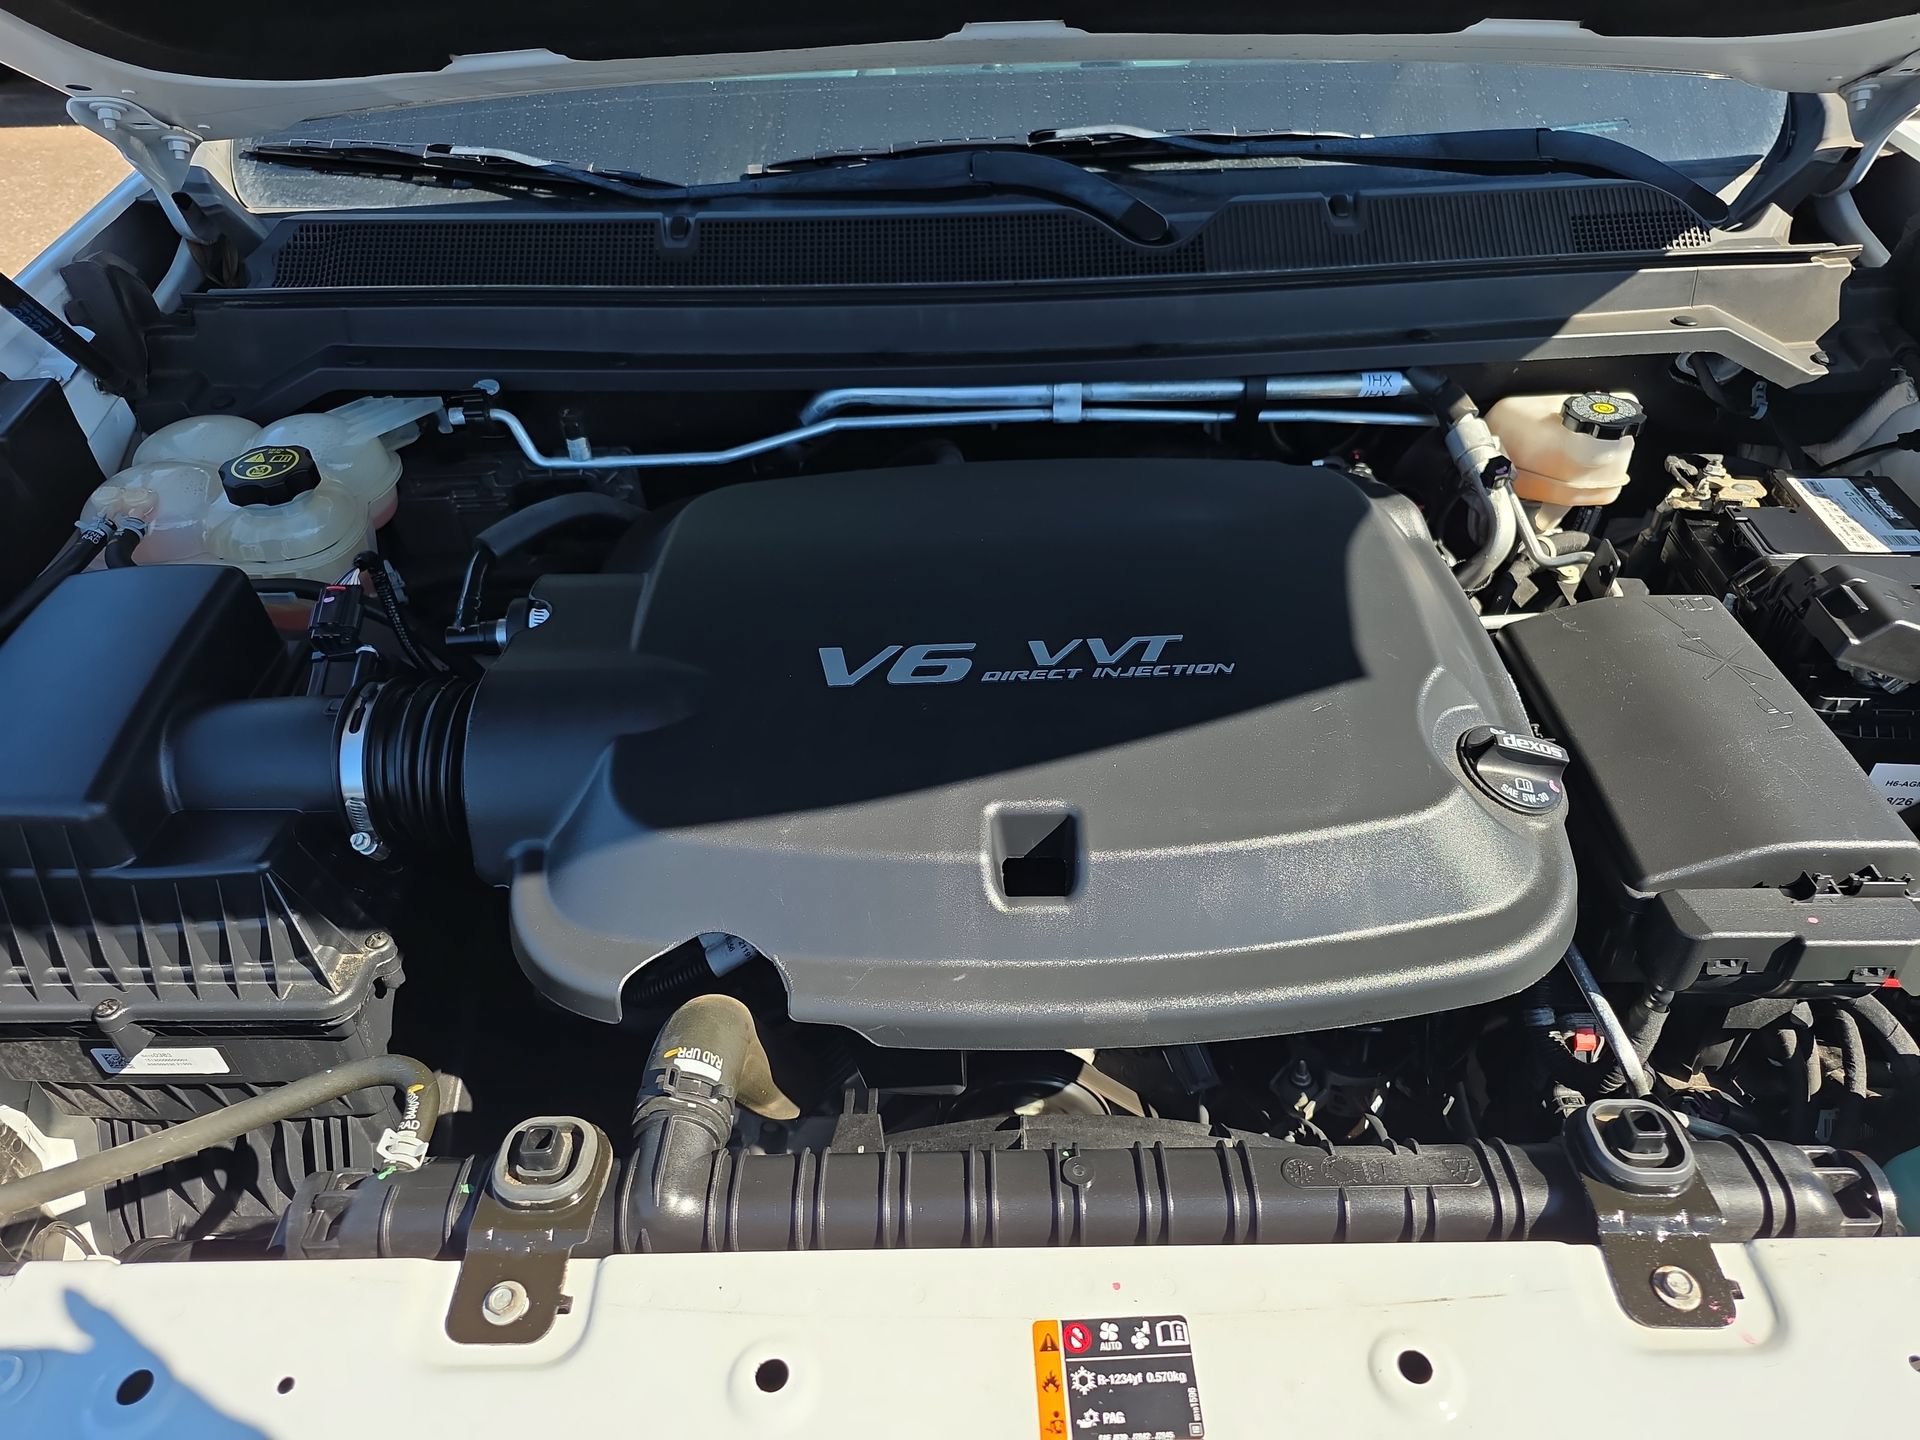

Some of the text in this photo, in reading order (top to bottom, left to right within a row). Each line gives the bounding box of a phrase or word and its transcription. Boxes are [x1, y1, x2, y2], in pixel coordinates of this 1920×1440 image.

[1027, 634, 1184, 666] VVT
[818, 642, 977, 687] V6
[980, 662, 1236, 682] DIRECT INJECTION
[1502, 733, 1563, 759] dexos
[1500, 783, 1550, 804] SAE 5W-30
[676, 1046, 724, 1070] RAD UPR
[1099, 1341, 1123, 1351] AUTO
[1097, 1371, 1188, 1387] R-1234yf 0.570kg
[1102, 1411, 1126, 1425] PAG
